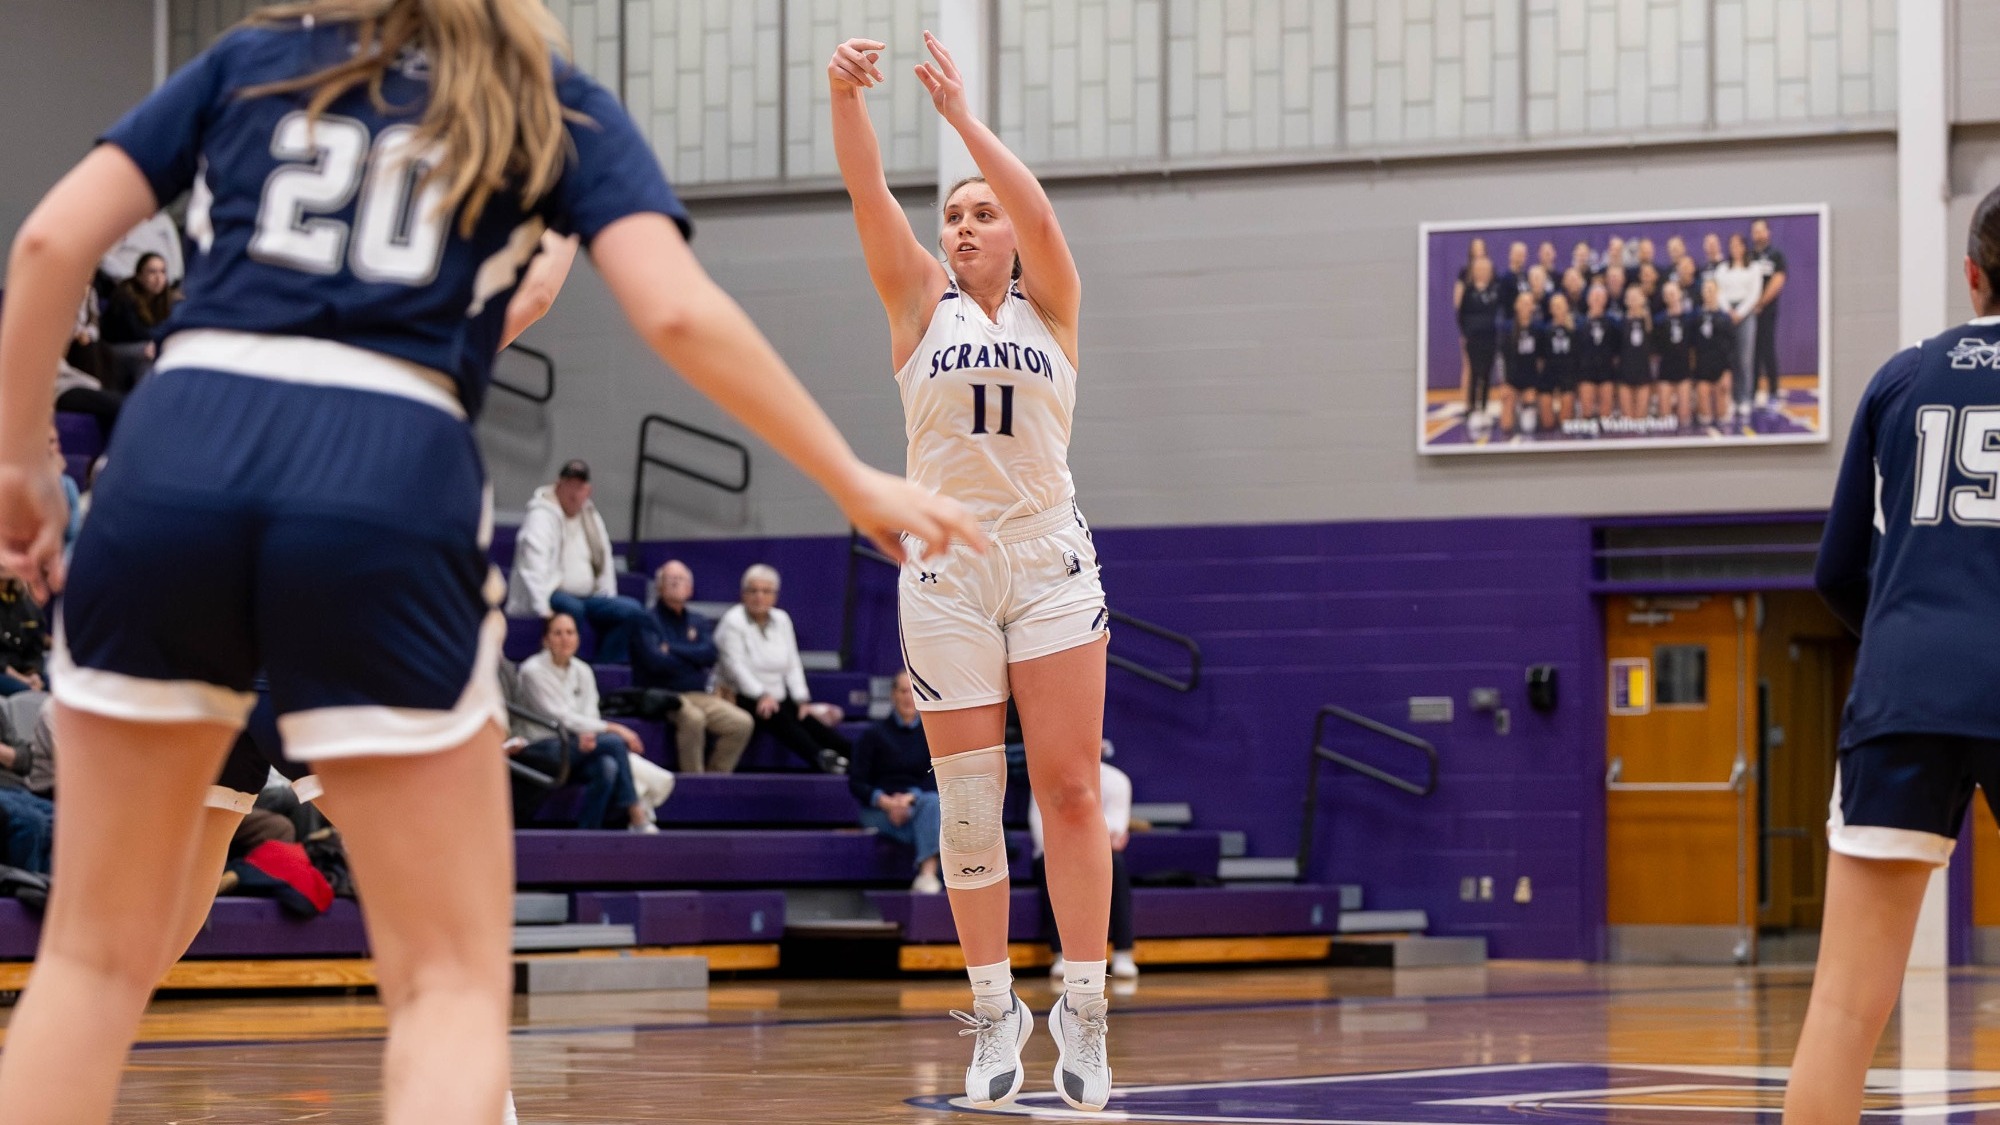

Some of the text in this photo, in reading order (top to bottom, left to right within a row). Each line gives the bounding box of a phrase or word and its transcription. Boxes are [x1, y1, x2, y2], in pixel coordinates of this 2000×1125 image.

[247, 110, 452, 287] 20
[929, 342, 1054, 383] SCRANTON
[968, 383, 1015, 438] 11
[1911, 405, 2000, 525] 15
